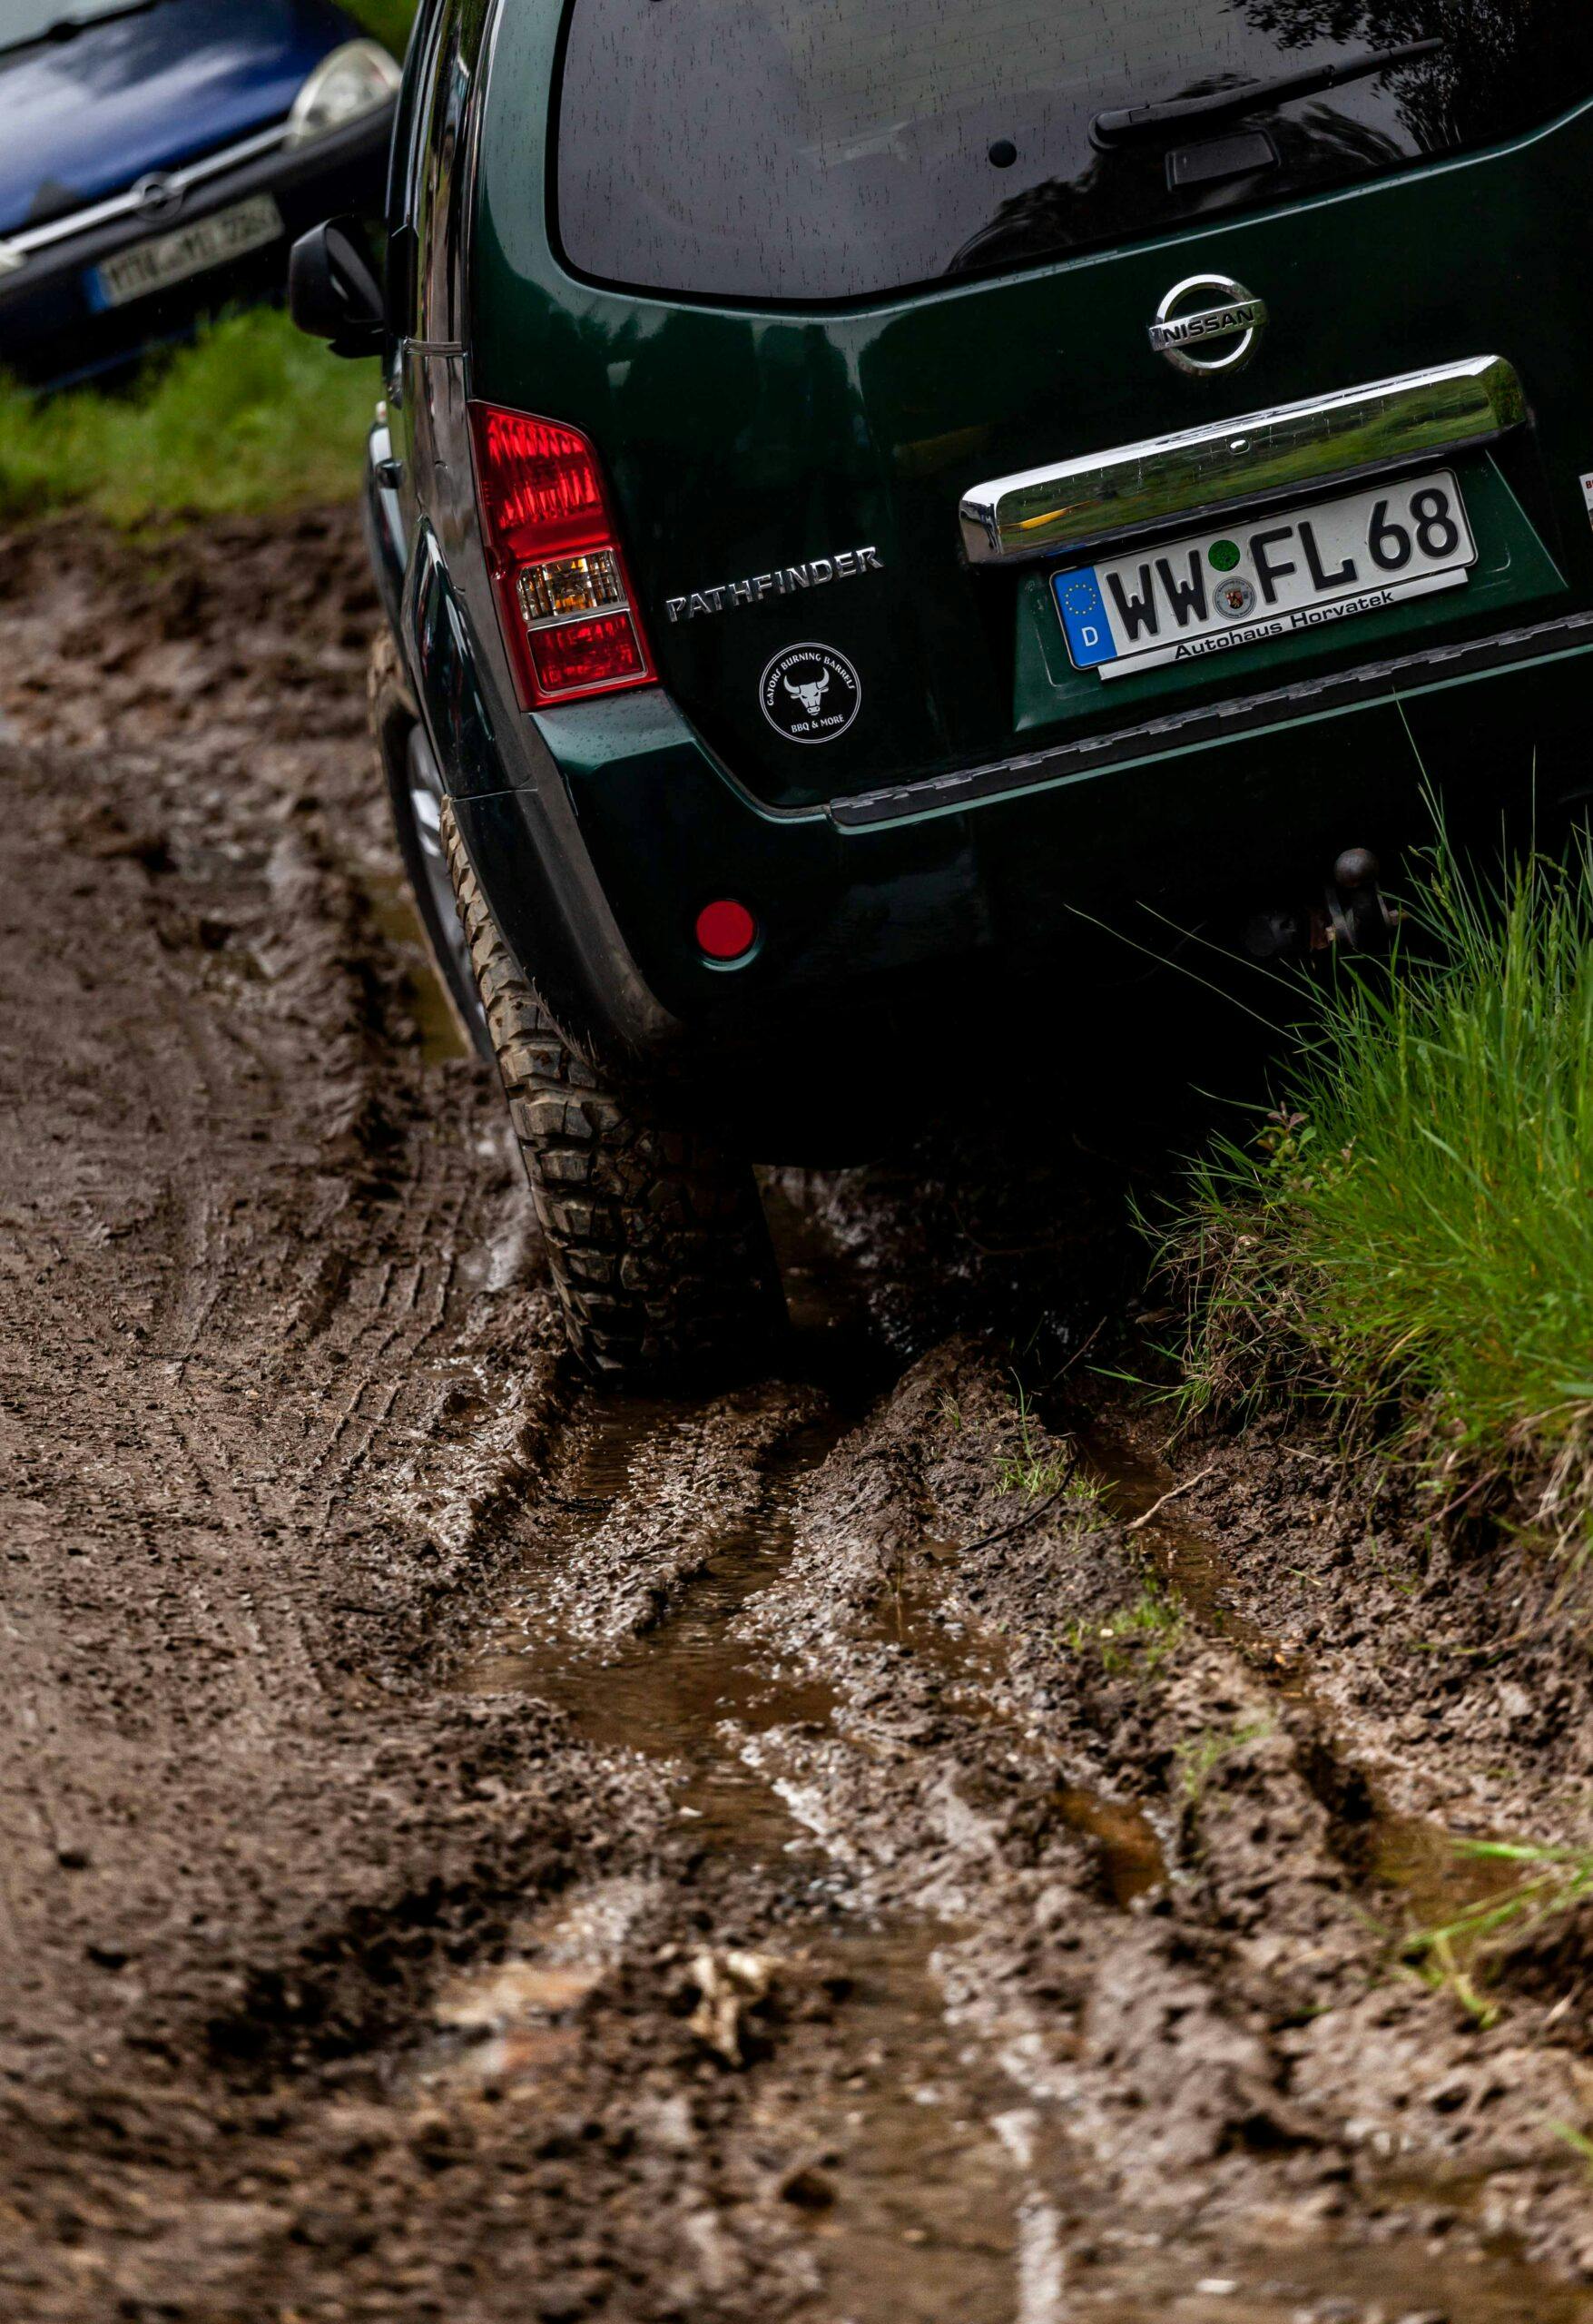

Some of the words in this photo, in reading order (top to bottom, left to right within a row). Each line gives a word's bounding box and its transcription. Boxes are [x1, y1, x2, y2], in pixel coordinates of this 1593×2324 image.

[1163, 307, 1254, 344] NISSAN
[665, 547, 883, 622] PATHFINDER
[1106, 549, 1210, 641] WW
[1249, 521, 1358, 604] FL
[1368, 487, 1459, 571] 68
[1081, 626, 1099, 647] D
[1175, 621, 1283, 660] Autohaus
[1290, 591, 1394, 628] Horvatek
[767, 668, 782, 706] GATORS
[781, 653, 821, 670] BURNING
[823, 656, 855, 689] BARRELS
[791, 722, 810, 733] BBQ
[820, 714, 845, 726] MORE
